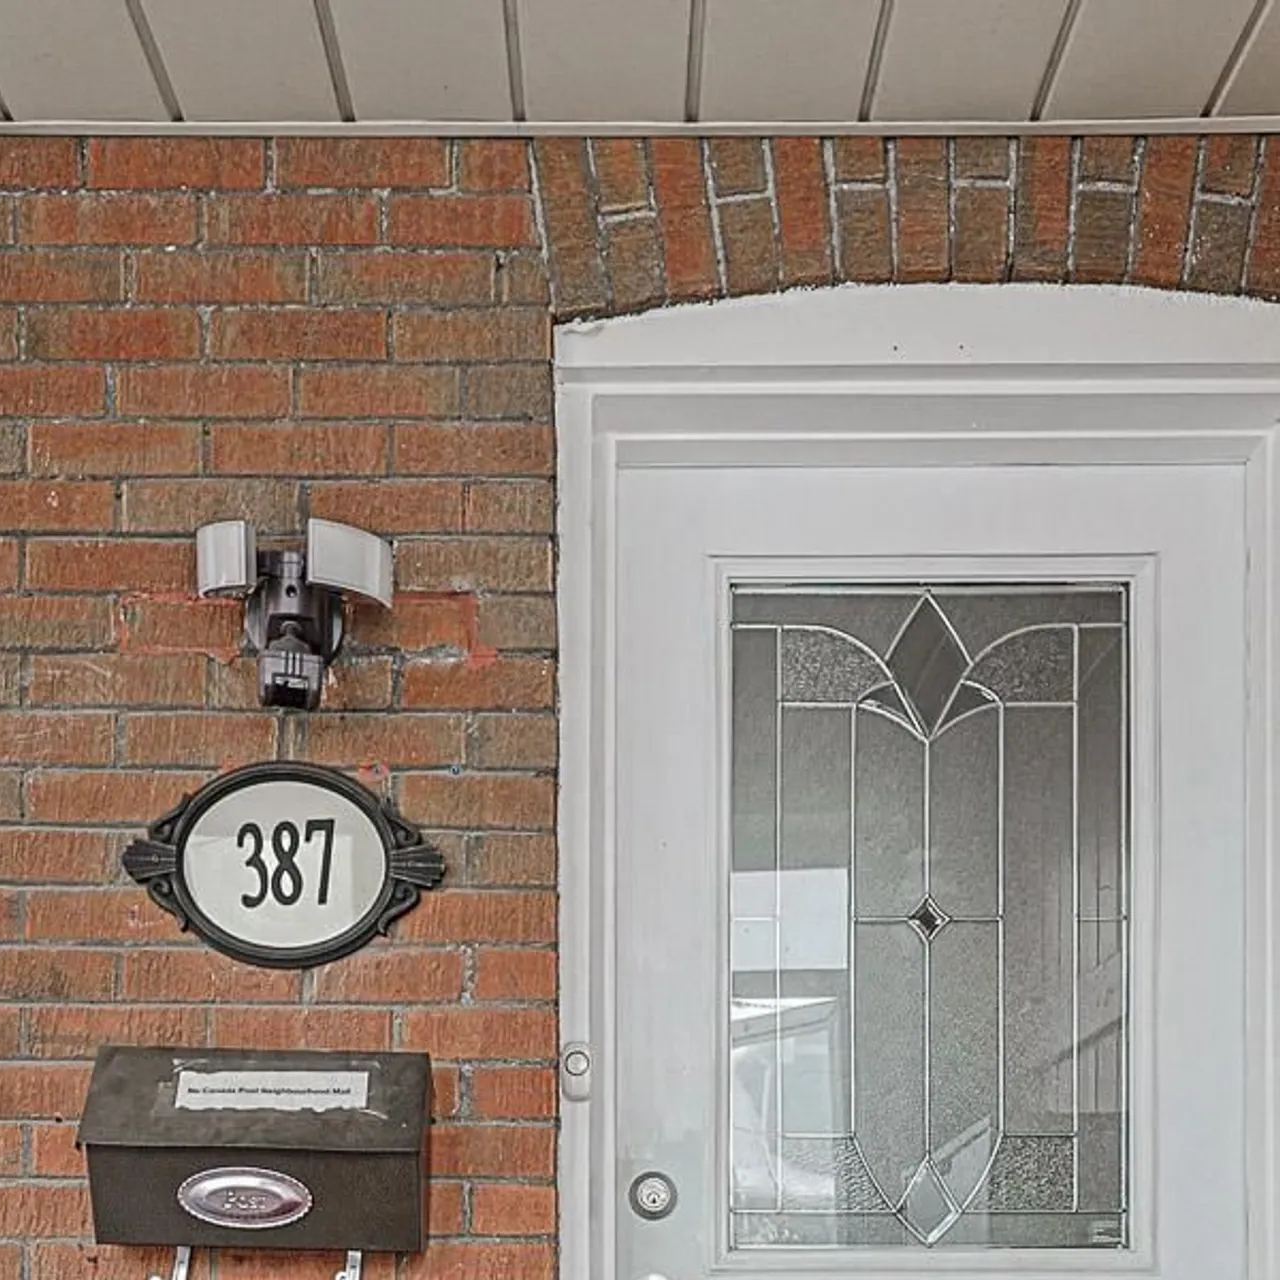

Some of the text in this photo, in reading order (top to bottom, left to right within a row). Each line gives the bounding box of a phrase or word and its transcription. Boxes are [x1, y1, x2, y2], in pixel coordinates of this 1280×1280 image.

[236, 818, 335, 908] 387
[202, 1086, 236, 1094] Canada
[238, 1086, 259, 1094] Post
[332, 1086, 351, 1094] Mail
[223, 1191, 267, 1210] Post
